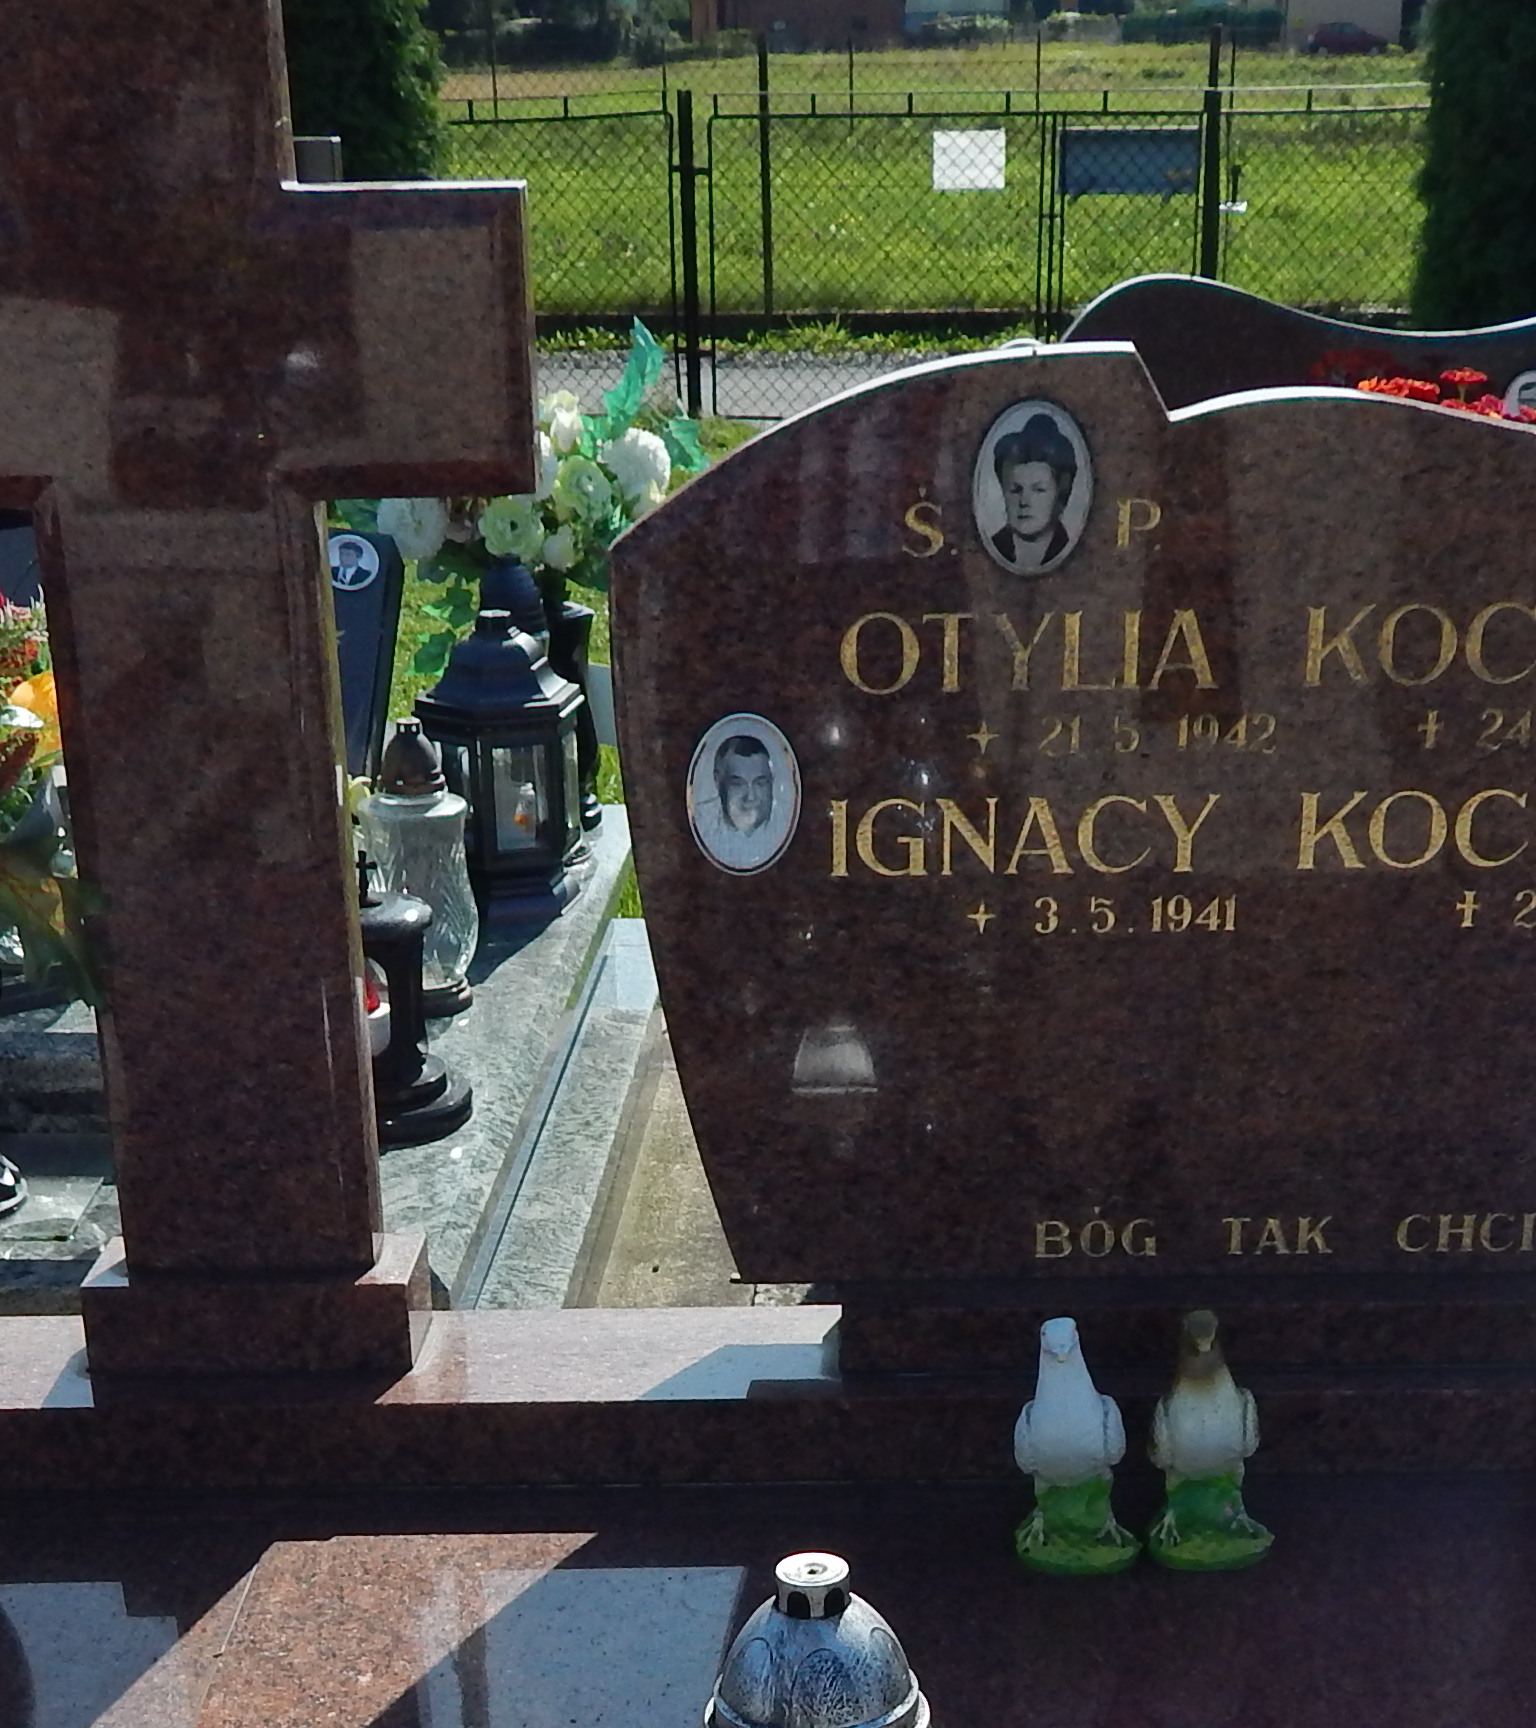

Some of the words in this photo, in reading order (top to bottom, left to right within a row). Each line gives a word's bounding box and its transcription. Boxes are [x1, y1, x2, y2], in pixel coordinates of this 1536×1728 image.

[839, 608, 1220, 696] OTYLIA
[829, 793, 1222, 878] IGNACY
[1034, 1206, 1157, 1259] BÓG
[1222, 1215, 1333, 1256] TAK
